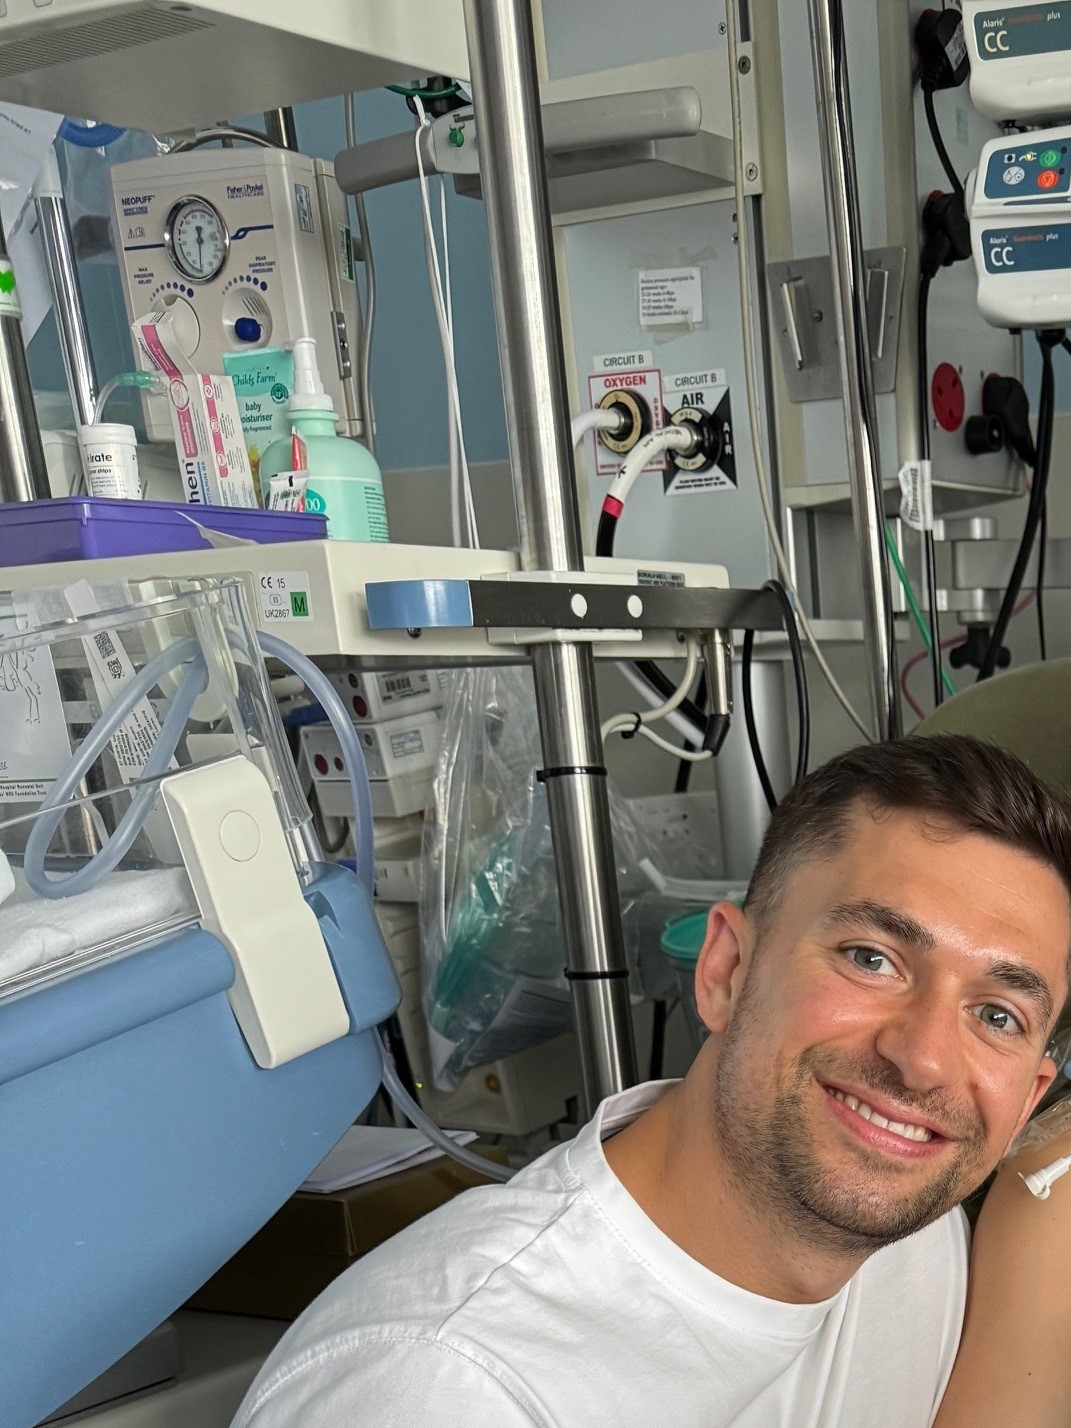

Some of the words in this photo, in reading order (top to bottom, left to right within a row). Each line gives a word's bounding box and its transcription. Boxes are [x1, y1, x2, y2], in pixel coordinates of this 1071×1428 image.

[983, 19, 1003, 28] Alaris
[1047, 11, 1061, 22] plus
[984, 31, 1010, 53] CC
[227, 186, 243, 194] Fisher
[121, 195, 152, 206] NEOPUFF
[1046, 233, 1059, 242] plus
[990, 247, 1015, 266] CC
[603, 355, 635, 367] CIRCUIT
[638, 354, 645, 364] B
[256, 371, 276, 384] Farm
[604, 374, 647, 388] OXYGEN
[675, 374, 709, 387] CIRCUIT
[711, 373, 717, 383] B
[681, 392, 705, 407] AIR
[245, 401, 261, 412] baby
[241, 413, 273, 423] oisturiser
[722, 422, 732, 455] AIR
[306, 498, 320, 511] 00
[277, 577, 286, 589] 15
[294, 597, 305, 613] M
[264, 608, 289, 618] UK2867
